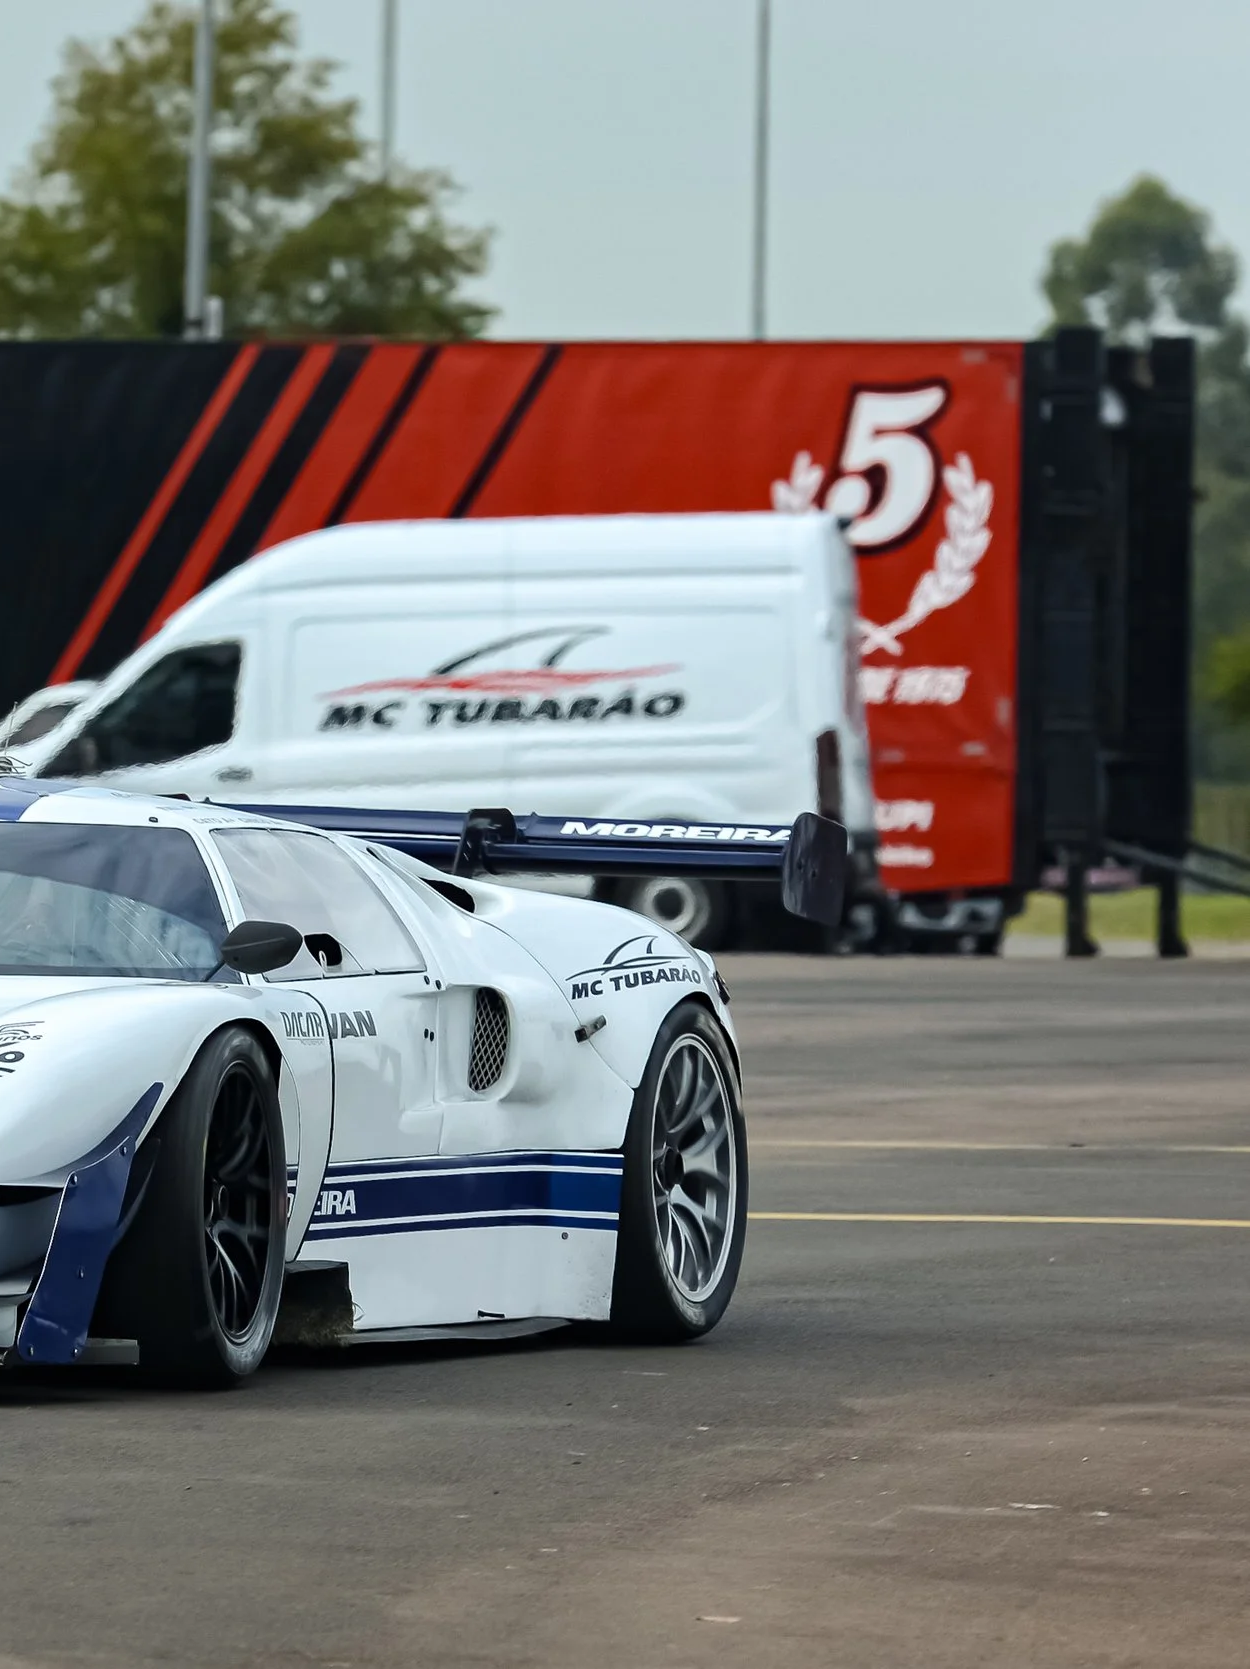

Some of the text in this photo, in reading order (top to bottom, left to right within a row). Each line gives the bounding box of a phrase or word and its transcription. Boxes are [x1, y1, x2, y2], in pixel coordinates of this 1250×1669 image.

[820, 380, 949, 550] 5
[318, 686, 688, 732] MC TUBARÃO
[571, 964, 702, 1000] MC TUBARÃO
